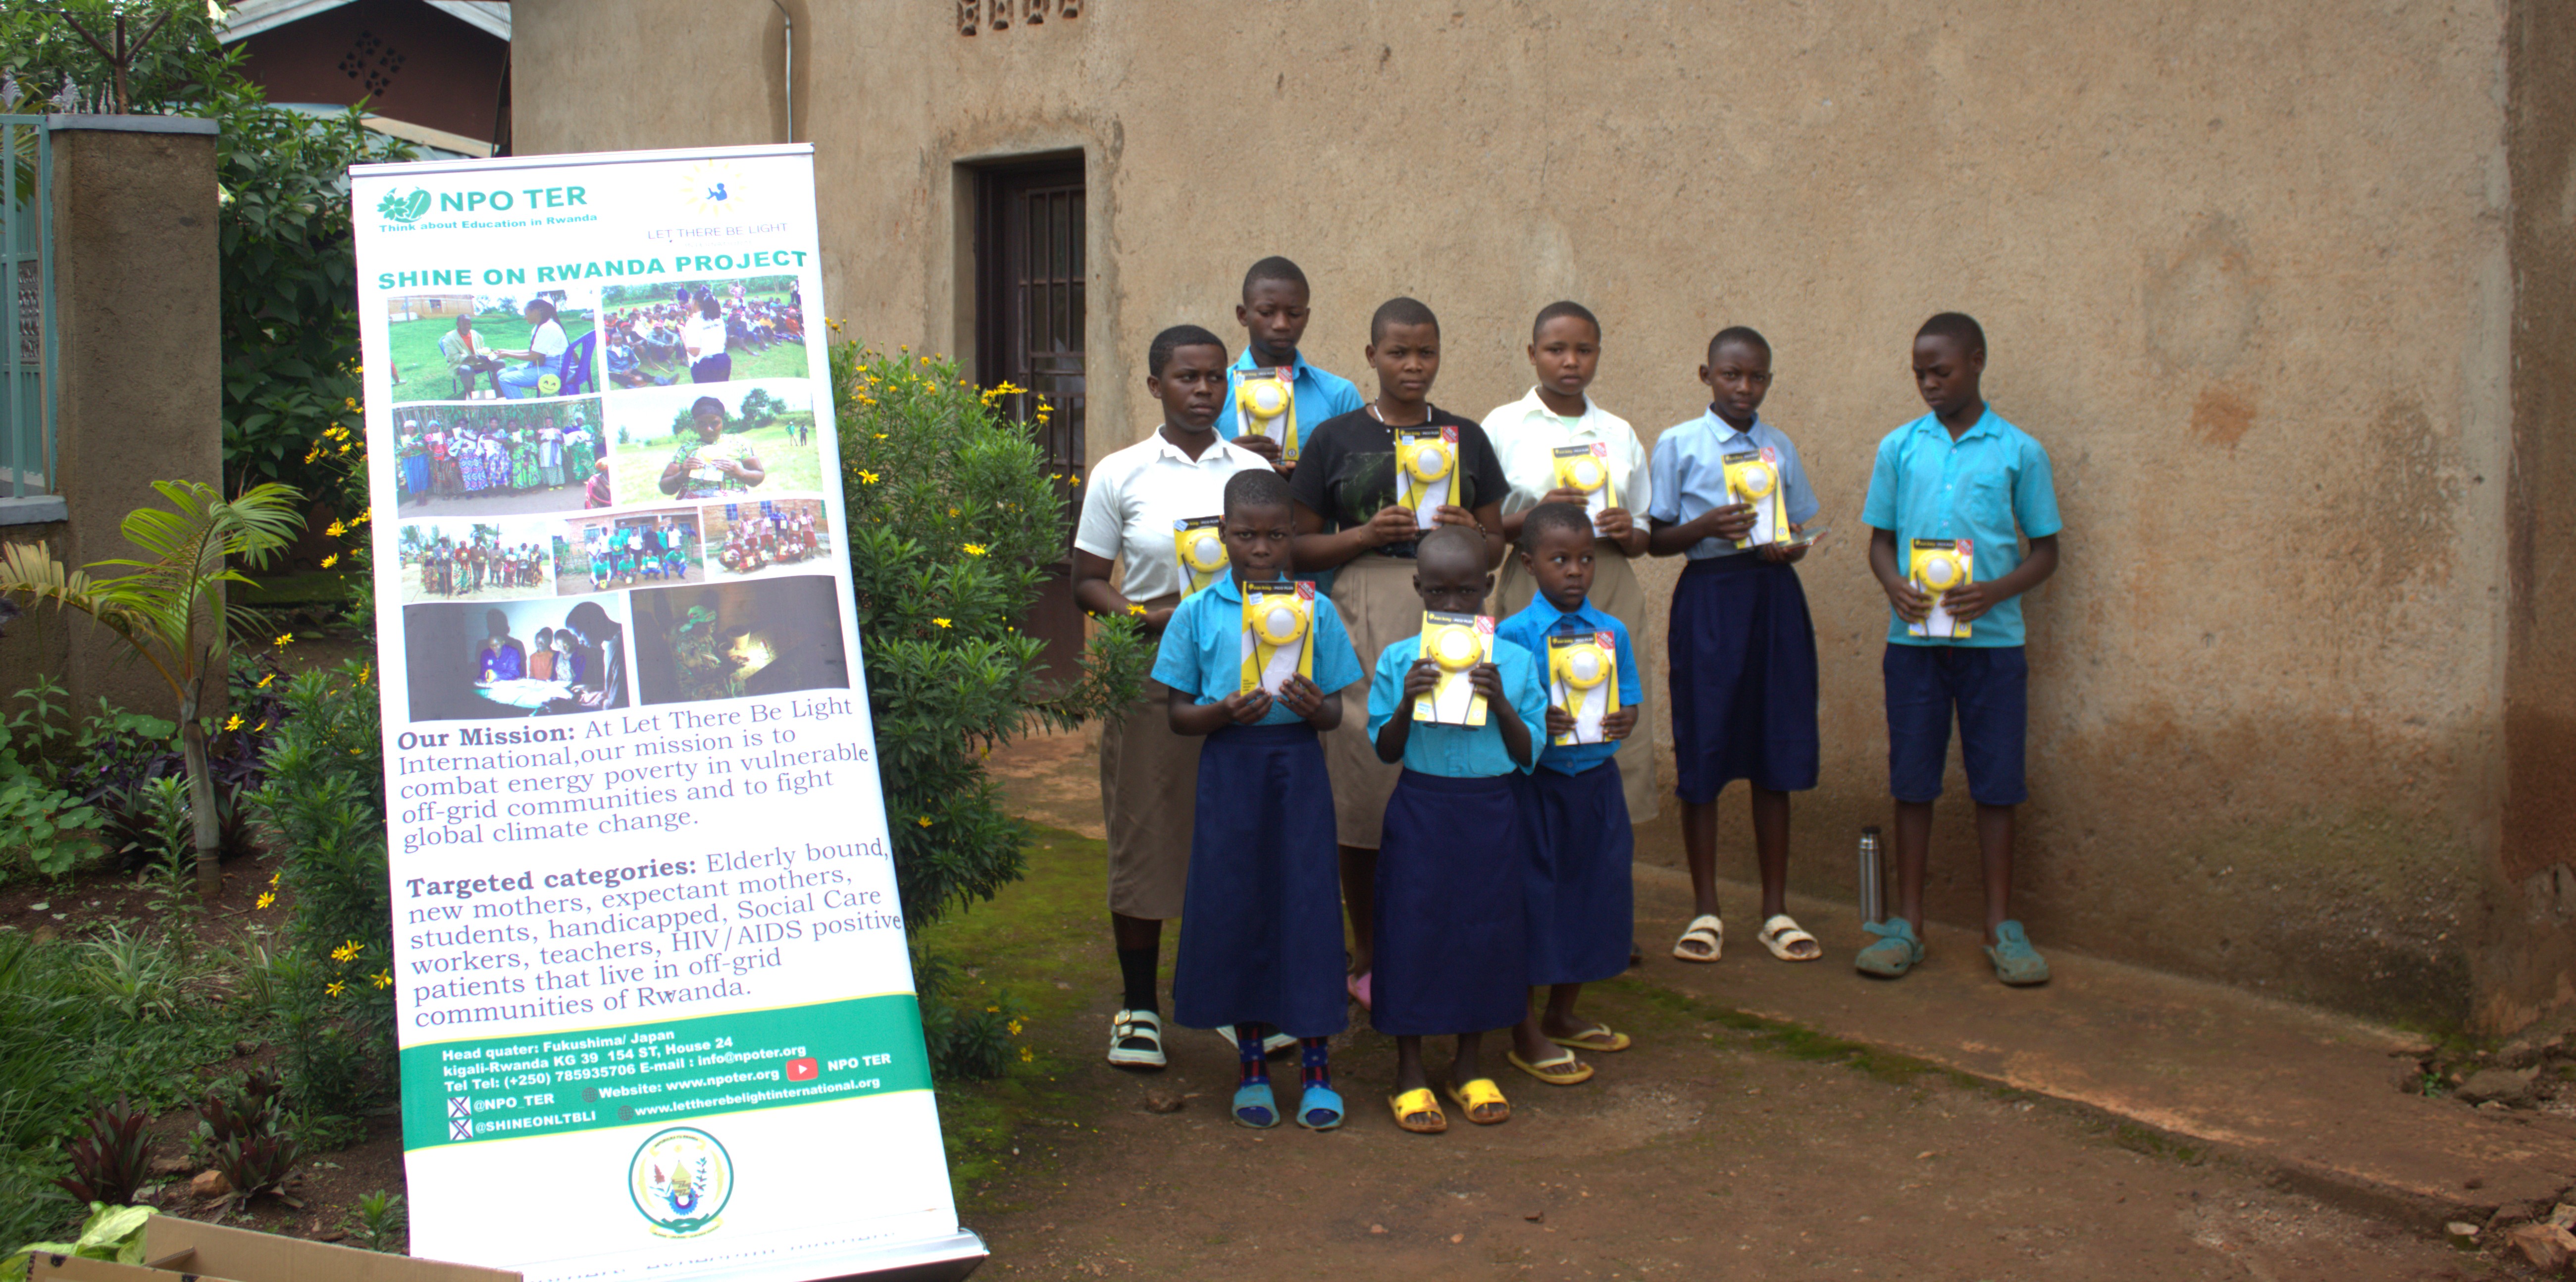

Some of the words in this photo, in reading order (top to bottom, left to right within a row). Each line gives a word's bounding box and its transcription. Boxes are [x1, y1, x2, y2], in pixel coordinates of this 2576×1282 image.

[440, 190, 514, 212] NPO
[522, 186, 587, 209] TER
[379, 223, 416, 232] Think
[462, 220, 526, 228] Education
[547, 214, 597, 224] Rwanda
[648, 229, 672, 239] LET
[676, 227, 721, 237] THERE
[725, 226, 743, 235] BE
[749, 222, 787, 234] LIGHT
[378, 269, 472, 289] SHINE
[483, 268, 525, 285] ON
[537, 258, 666, 283] RWANDA
[675, 250, 807, 272] PROJECT
[397, 732, 449, 750] Our
[459, 725, 574, 746] Mission:
[585, 721, 612, 738] At
[623, 715, 660, 734] Let
[669, 711, 740, 729] There
[751, 705, 781, 722] Be
[792, 697, 852, 720] Light
[635, 734, 732, 756] mission
[743, 730, 762, 747] is
[773, 729, 795, 743] to
[401, 776, 498, 799] combat
[508, 774, 593, 793] energy
[605, 761, 697, 790] poverty
[708, 756, 731, 774] in
[741, 743, 868, 770] vulnerable
[402, 799, 497, 824] off-grid
[508, 786, 677, 816] communities
[687, 779, 733, 800] and
[744, 780, 767, 795] to
[777, 770, 832, 795] fight
[404, 824, 483, 854] global
[493, 821, 588, 841] climate
[599, 812, 697, 833] change.
[406, 871, 534, 899] Targeted
[544, 859, 696, 888] categories:
[707, 847, 795, 872] Elderly
[805, 838, 887, 861] bound,
[409, 906, 463, 924] new
[473, 896, 591, 918] mothers,
[602, 880, 728, 910] expectant
[739, 870, 851, 894] mothers,
[411, 925, 537, 949] students,
[548, 904, 727, 938] handicapped,
[738, 893, 814, 918] Social
[824, 890, 880, 908] Care
[411, 951, 528, 974] workers,
[540, 941, 661, 964] teachers,
[671, 920, 802, 952] HIV/AIDS
[812, 910, 901, 941] positive
[414, 976, 525, 1008] patients
[535, 970, 590, 991] that
[599, 966, 643, 985] live
[654, 960, 679, 979] in
[689, 947, 781, 975] off-grid
[415, 996, 593, 1027] communities
[604, 989, 629, 1010] of
[637, 978, 750, 1007] Rwanda.
[442, 1048, 481, 1061] Head
[486, 1045, 538, 1060] quater:
[543, 1035, 625, 1052] Fukushima/
[630, 1031, 674, 1044] Japan
[443, 1059, 548, 1078] kigali-Rwanda
[554, 1055, 575, 1067] KG
[581, 1053, 598, 1064] 39
[608, 1049, 634, 1061] 154
[638, 1046, 661, 1058] ST,
[665, 1042, 711, 1055] House
[715, 1037, 733, 1049] 24
[827, 1058, 858, 1071] NPO
[862, 1054, 891, 1066] TER
[444, 1080, 467, 1092] Tel
[472, 1078, 499, 1089] Tel:
[504, 1073, 550, 1089] (+250)
[555, 1064, 635, 1082] 785935706
[640, 1058, 684, 1073] E-mail
[698, 1046, 806, 1066] info@npoter.org
[599, 1084, 661, 1098] Website:
[666, 1070, 779, 1091] www.npoter.org
[474, 1094, 554, 1112] @NPO_TER
[635, 1079, 879, 1116] www.lettherebelightinternational.org
[475, 1111, 595, 1133] @SHINEONLTBLI
